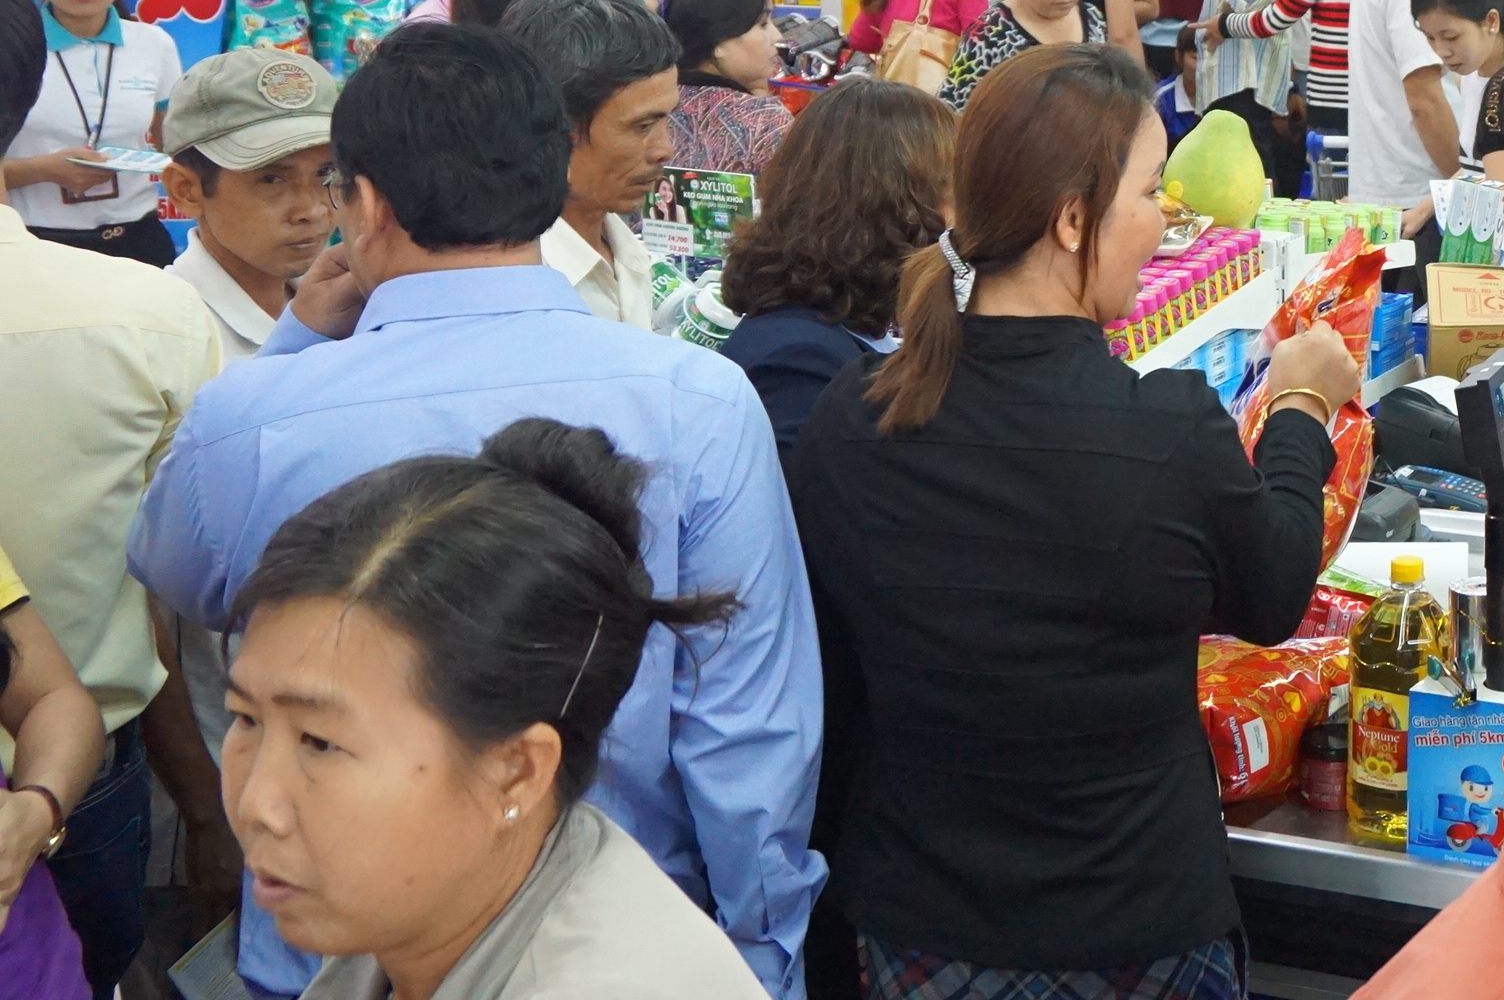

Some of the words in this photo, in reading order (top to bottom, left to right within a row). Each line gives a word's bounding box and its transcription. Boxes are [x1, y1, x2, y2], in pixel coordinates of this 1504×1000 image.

[700, 180, 738, 195] XYLITOL
[697, 192, 712, 201] GUM
[712, 193, 726, 203] NHA
[726, 194, 744, 204] KHOA
[1412, 715, 1438, 728] Giao
[1440, 714, 1466, 729] hàng
[1468, 715, 1486, 729] tận
[1358, 725, 1401, 744] Neptune
[1415, 730, 1450, 747] miễn
[1454, 731, 1477, 749] phí
[1371, 740, 1399, 755] Gold
